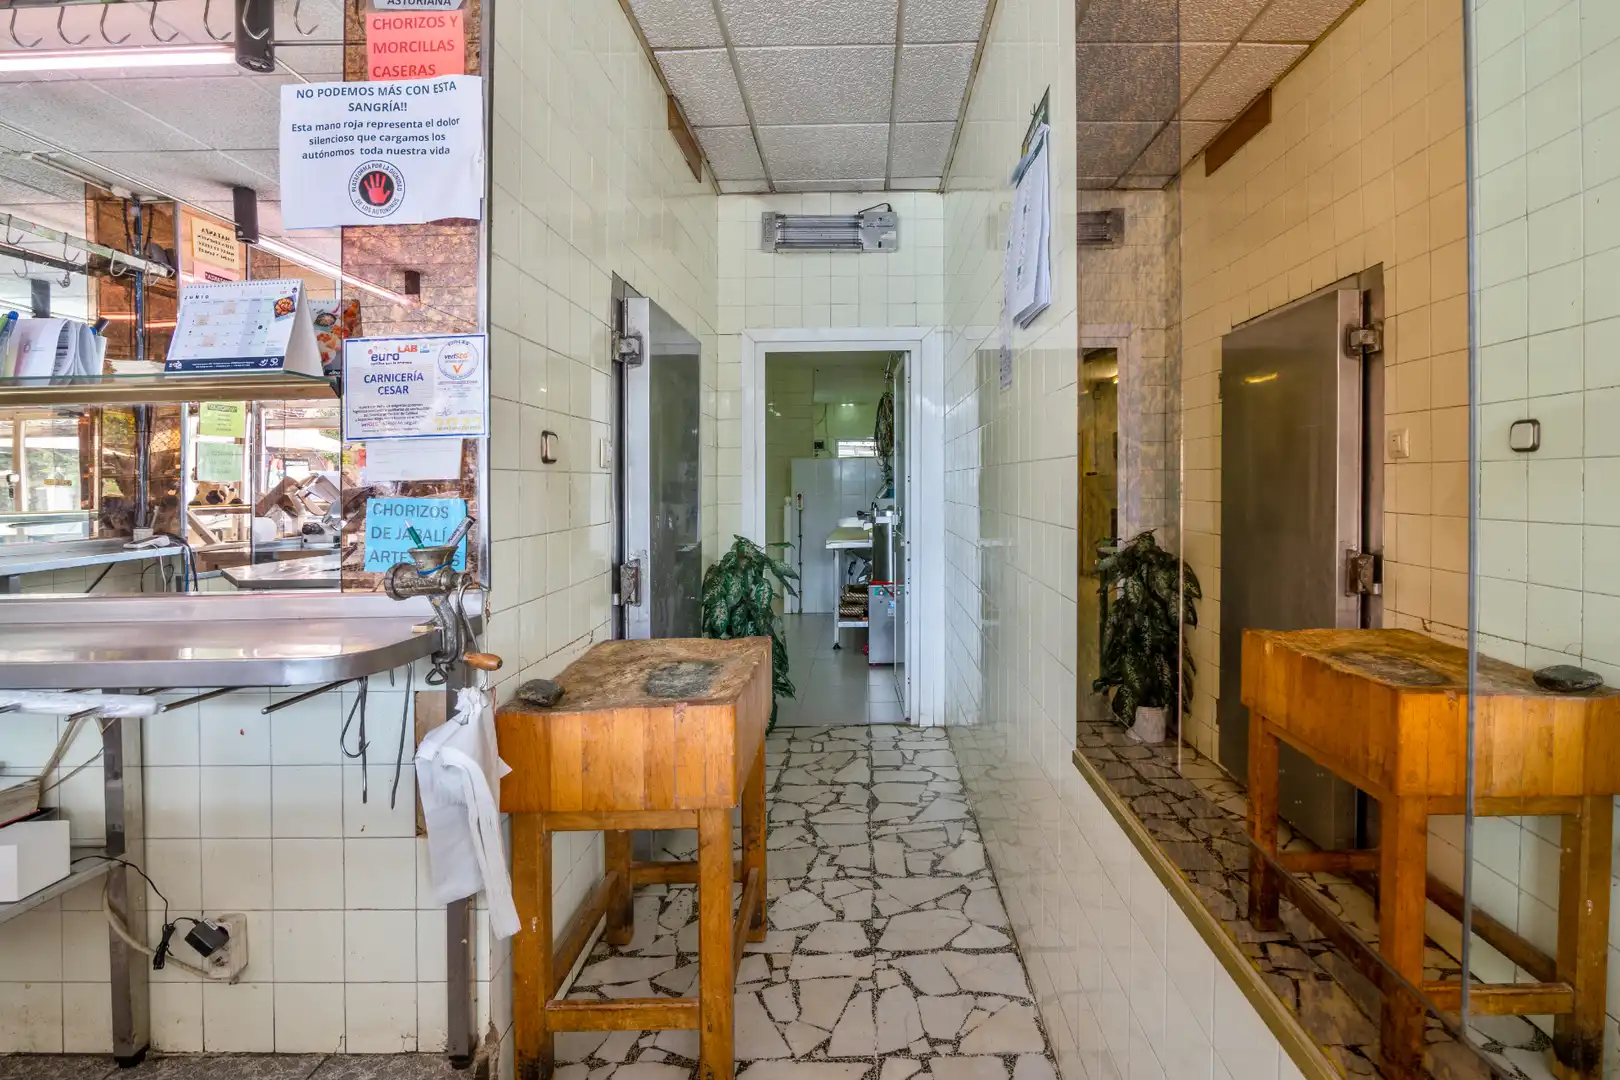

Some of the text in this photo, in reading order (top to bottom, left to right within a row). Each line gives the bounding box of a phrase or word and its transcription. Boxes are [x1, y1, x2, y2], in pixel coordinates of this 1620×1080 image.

[372, 16, 458, 30] CHORIZOS Y
[373, 40, 454, 54] MORCILLAS
[372, 64, 436, 78] CASERAS
[296, 81, 456, 99] NO PODEMOS MÁS CON ESTA
[348, 100, 408, 112] SANGRÍA!!
[292, 117, 460, 132] Esta mano roja representa el dolor
[309, 133, 446, 146] silencioso que cargamos los
[302, 148, 354, 160] autónomos
[360, 147, 383, 155] toda
[430, 146, 450, 155] vida
[371, 345, 418, 362] euro LAB
[364, 370, 424, 384] CARNICERÍA
[378, 385, 409, 396] CESAR
[373, 503, 448, 519] CHORIZOS
[371, 526, 391, 540] DE
